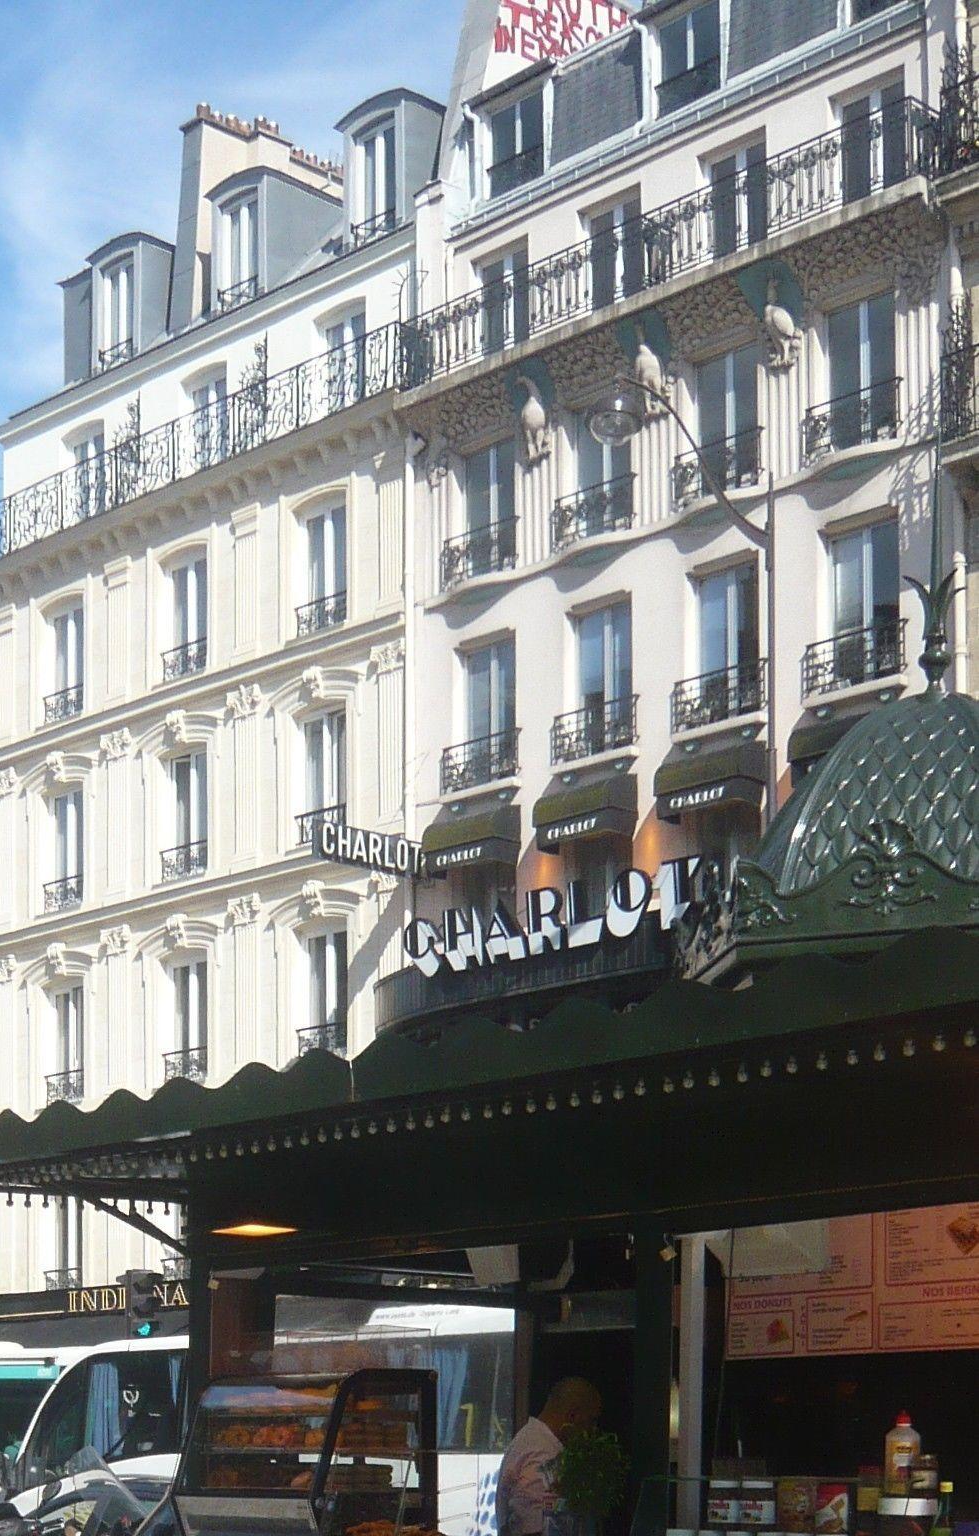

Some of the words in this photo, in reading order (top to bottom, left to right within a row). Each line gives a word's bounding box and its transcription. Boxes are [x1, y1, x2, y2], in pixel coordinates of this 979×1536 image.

[670, 786, 724, 809] CHARLOT
[547, 818, 596, 840] CHARLOT
[321, 822, 422, 873] CHARLOT
[435, 847, 482, 867] CHARLOT
[403, 855, 703, 978] CHARLOT
[67, 1282, 190, 1312] INDINA
